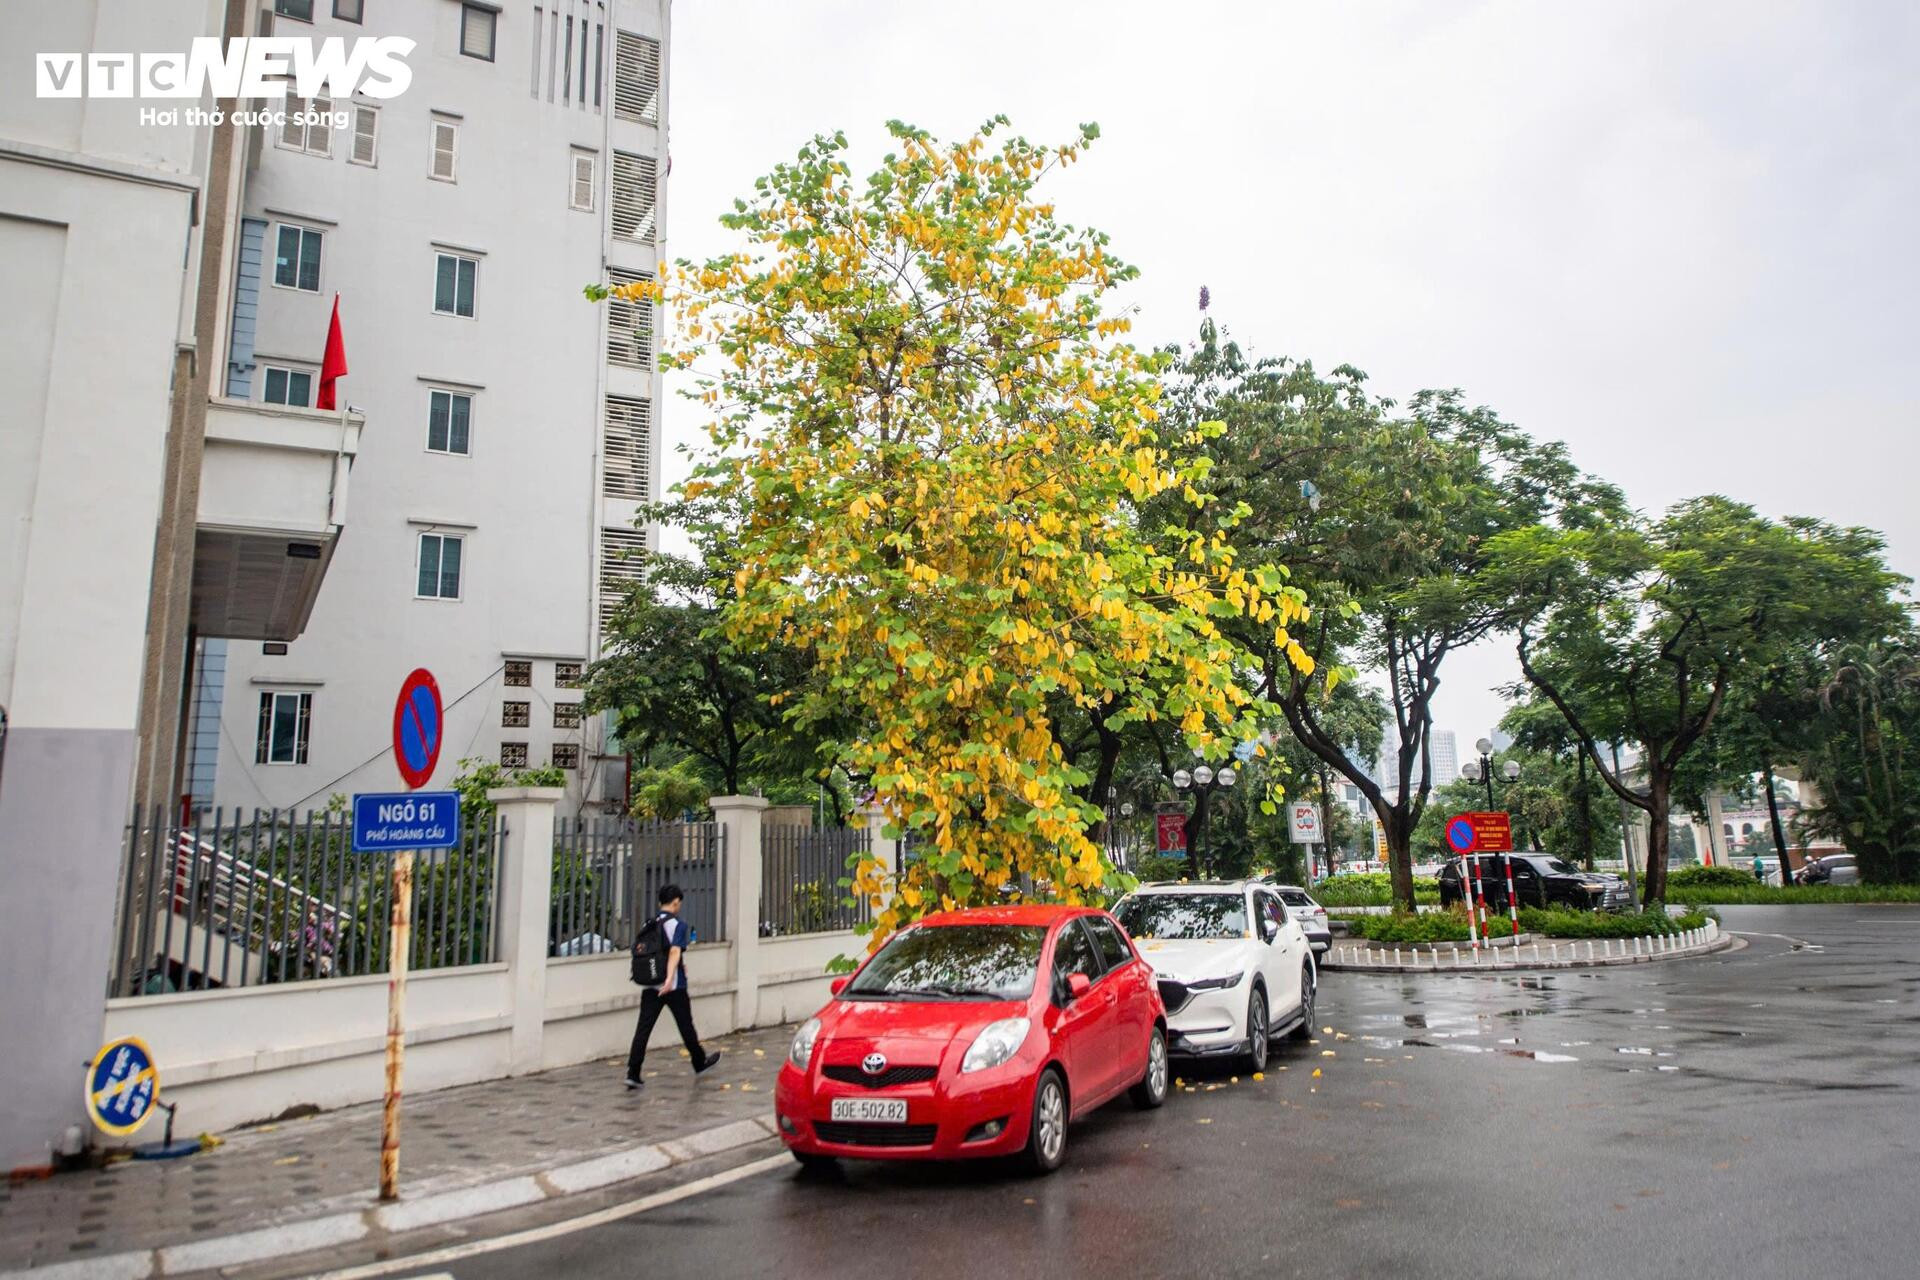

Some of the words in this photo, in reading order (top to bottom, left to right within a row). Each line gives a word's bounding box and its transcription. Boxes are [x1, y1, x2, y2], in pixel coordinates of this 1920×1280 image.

[378, 800, 415, 823] NGÕ
[418, 802, 436, 822] 61
[365, 826, 388, 841] PHỐ
[388, 827, 424, 840] HOÀNG
